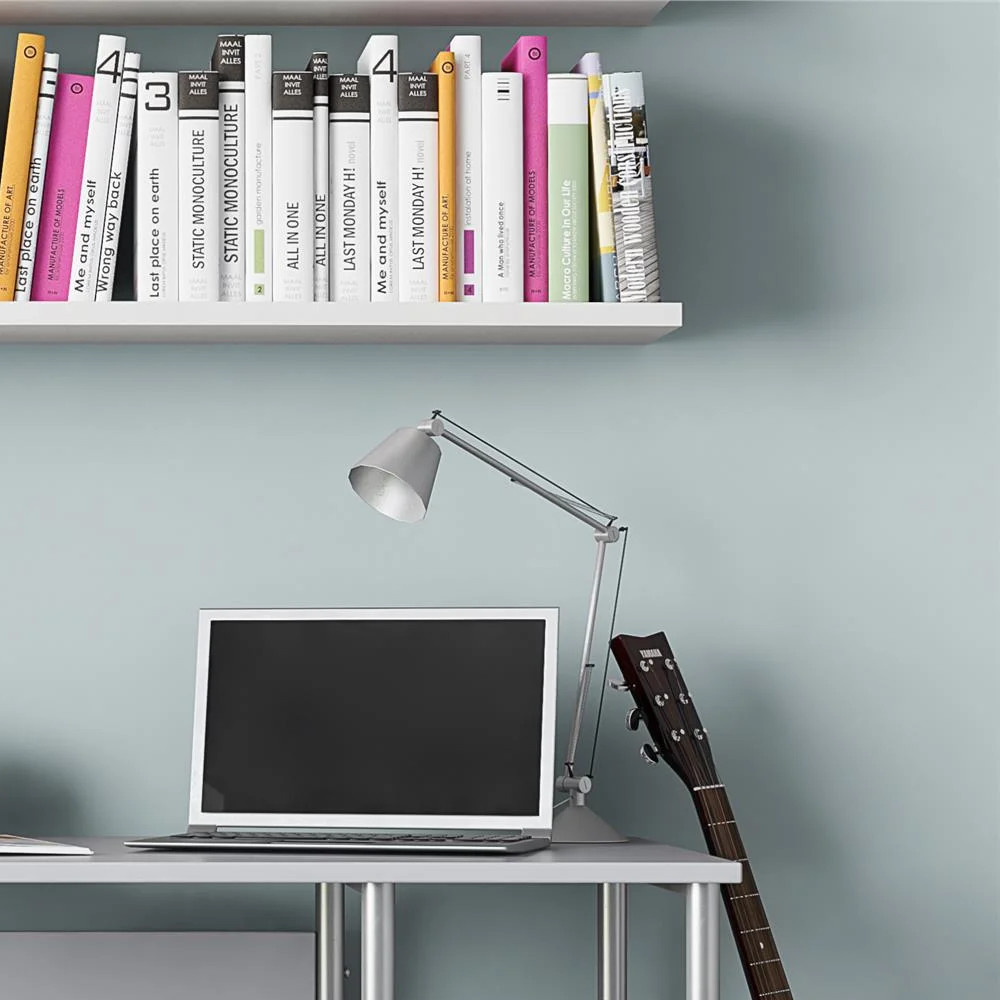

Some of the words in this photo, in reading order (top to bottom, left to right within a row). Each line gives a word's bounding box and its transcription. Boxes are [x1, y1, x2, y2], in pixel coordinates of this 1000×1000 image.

[96, 50, 121, 83] 4
[373, 49, 397, 83] 4
[145, 82, 170, 111] 3
[224, 104, 238, 212] MONOCULTURE
[346, 141, 356, 164] novel
[415, 141, 425, 163] novel
[463, 152, 472, 173] home
[28, 157, 42, 193] earth
[149, 168, 159, 202] earth
[192, 130, 205, 224] MONOCULTURE
[343, 168, 356, 181] H!
[412, 168, 425, 180] H!
[528, 170, 536, 202] MODELS
[81, 180, 97, 228] myself
[106, 172, 122, 209] back
[376, 181, 388, 230] myself
[27, 199, 37, 215] on
[151, 207, 159, 224] on
[287, 202, 299, 228] ONE
[315, 194, 326, 222] ONE
[343, 184, 356, 238] MONDAY
[412, 183, 425, 237] MONDAY
[441, 212, 449, 222] OF
[528, 205, 536, 216] OF
[561, 199, 570, 216] Our
[19, 220, 34, 261] place
[47, 228, 60, 280] MANUFACTURE
[54, 189, 65, 216] MODELS
[105, 213, 118, 242] way
[224, 217, 238, 263] STATIC
[287, 232, 299, 244] IN
[315, 227, 326, 239] IN
[77, 233, 91, 263] and
[149, 229, 161, 267] place
[192, 229, 205, 269] STATIC
[287, 246, 299, 269] ALL
[315, 242, 326, 266] ALL
[343, 241, 356, 271] LAST
[377, 235, 387, 264] and
[412, 240, 425, 270] LAST
[441, 224, 449, 280] MANUFACTURE
[528, 219, 536, 277] MANUFACTURE
[561, 231, 571, 265] Culture
[74, 268, 86, 292] Me
[97, 248, 114, 292] Wrong
[149, 272, 159, 297] Last
[377, 269, 387, 294] Me
[562, 268, 571, 299] Macro
[639, 648, 662, 658] YAMAHA
